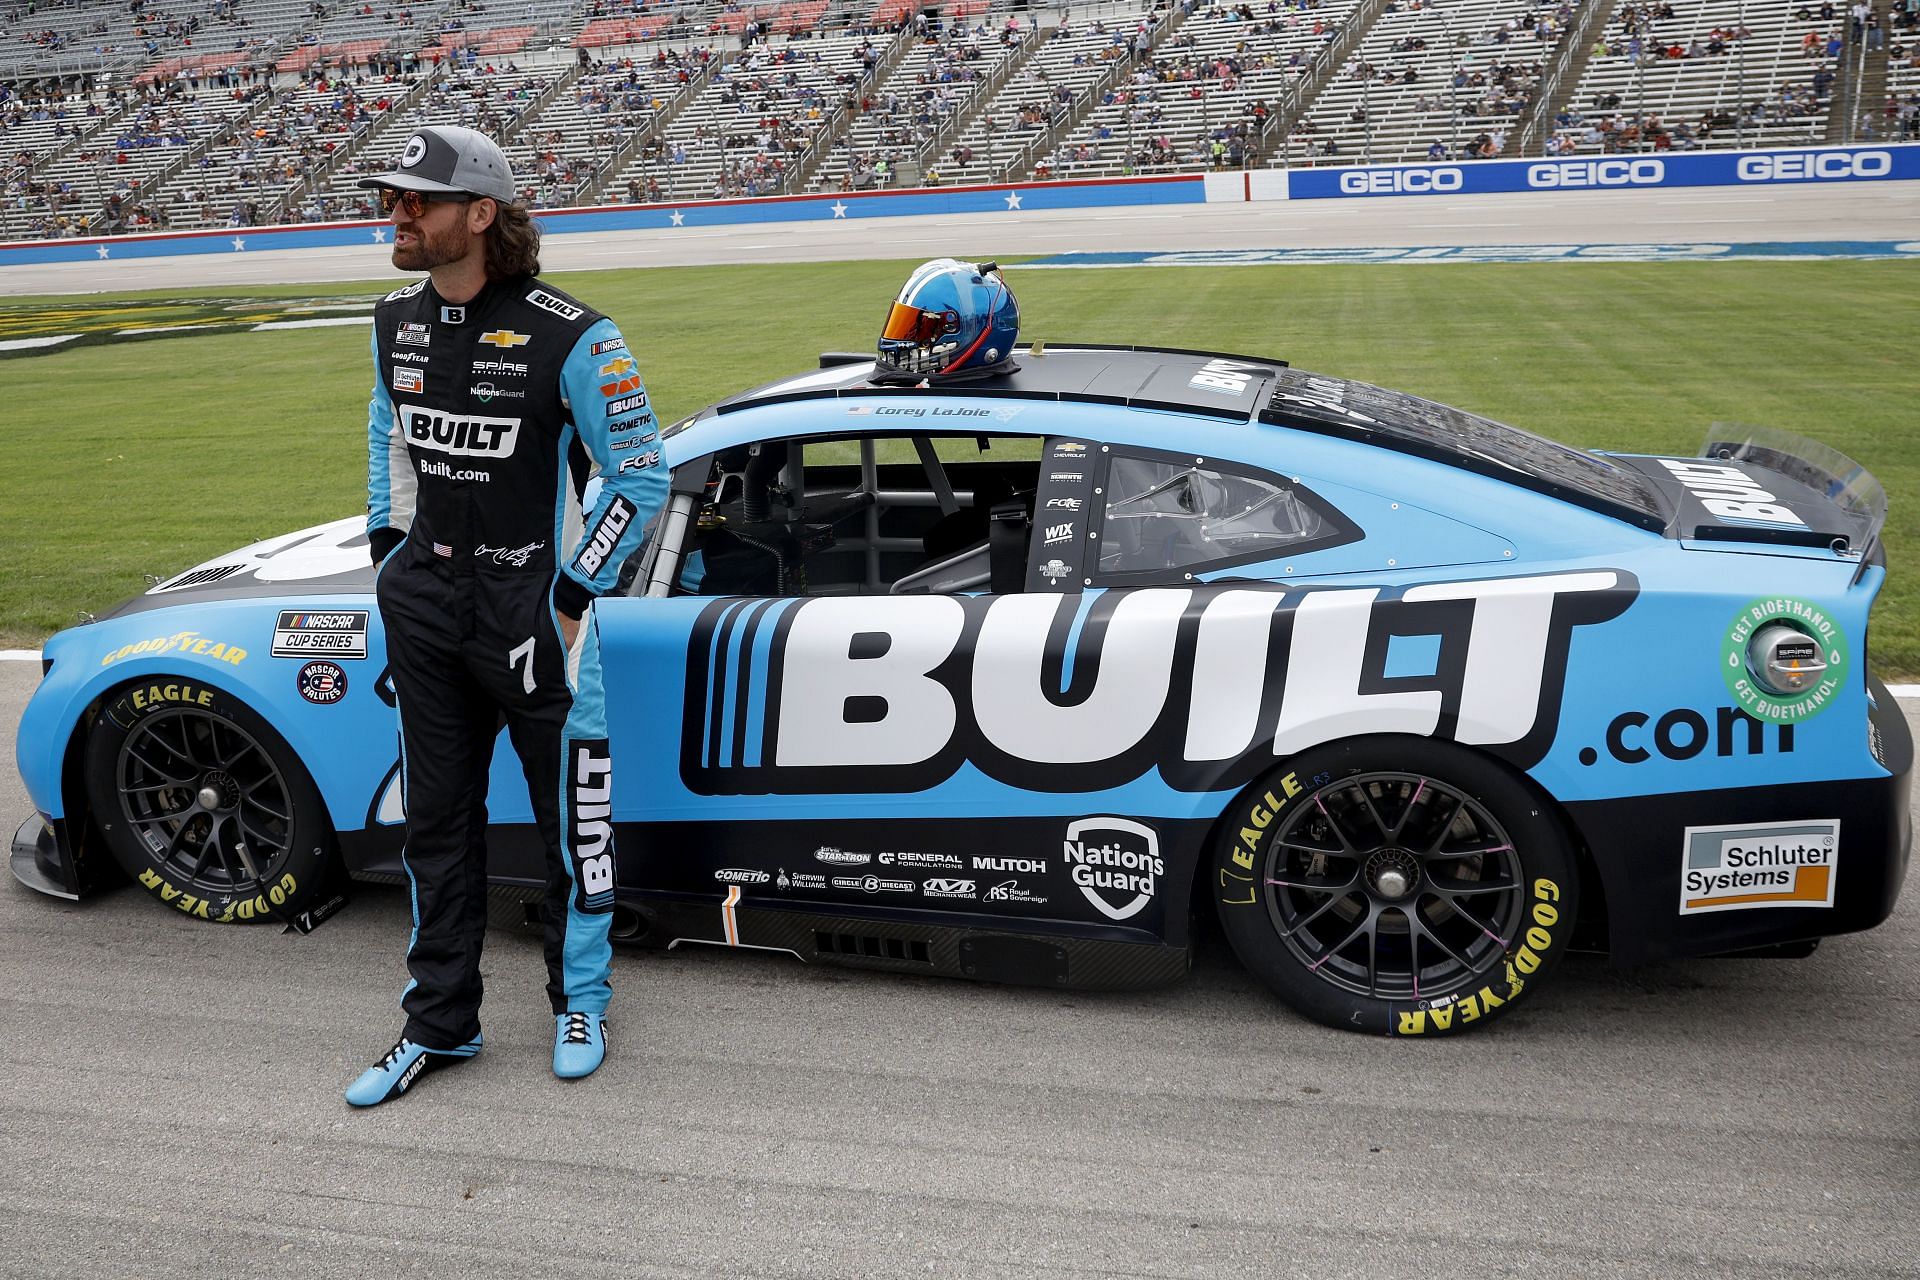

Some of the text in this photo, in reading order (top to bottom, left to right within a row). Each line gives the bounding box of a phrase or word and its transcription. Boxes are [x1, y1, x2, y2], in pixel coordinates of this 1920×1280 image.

[407, 144, 421, 157] B
[1527, 159, 1665, 187] GEICO
[1737, 150, 1892, 181] GEICO
[1339, 167, 1463, 194] GEICO
[448, 309, 462, 323] B
[533, 292, 582, 318] BUILT
[472, 354, 528, 372] SPIRE
[612, 393, 645, 414] BUILT
[875, 406, 991, 417] Corey LaJoie
[411, 412, 513, 452] BUILT
[609, 413, 652, 433] COMETIC
[421, 458, 490, 482] Built.com
[1657, 459, 1806, 525] BUILT
[580, 497, 632, 577] BUILT
[1045, 522, 1074, 539] WIX
[305, 615, 355, 629] NASCAR
[1731, 599, 1836, 645] GET BIOETHANOL
[102, 631, 248, 666] GOODYEAR
[286, 634, 353, 648] CUP SERIES
[1779, 647, 1814, 656] SPIRE
[304, 664, 340, 680] NASCAR
[509, 636, 538, 695] 7
[775, 571, 1618, 767] BUILT
[132, 684, 214, 709] EAGLE
[303, 685, 341, 701] SALUTES
[1735, 677, 1838, 719] GET BIOETHANOL
[576, 748, 612, 898] BUILT
[1232, 771, 1303, 870] EAGLE
[897, 852, 962, 864] GENERAL
[897, 861, 963, 869] FORMULATIONS
[972, 856, 1046, 873] MUTOH
[1063, 841, 1164, 876] Nations
[1727, 844, 1832, 867] Schluter
[714, 869, 770, 883] COMETIC
[792, 872, 825, 882] SHERWIN
[833, 879, 860, 887] CIRCLE
[864, 879, 879, 890] B
[881, 882, 913, 890] DIECAST
[1071, 864, 1155, 896] Guard
[1686, 867, 1790, 895] Systems
[990, 886, 1030, 900] RS Royal
[1009, 894, 1047, 904] Sovereign
[300, 911, 312, 930] 7
[1398, 878, 1560, 1035] GOODYEAR
[400, 1053, 426, 1090] BUILT
